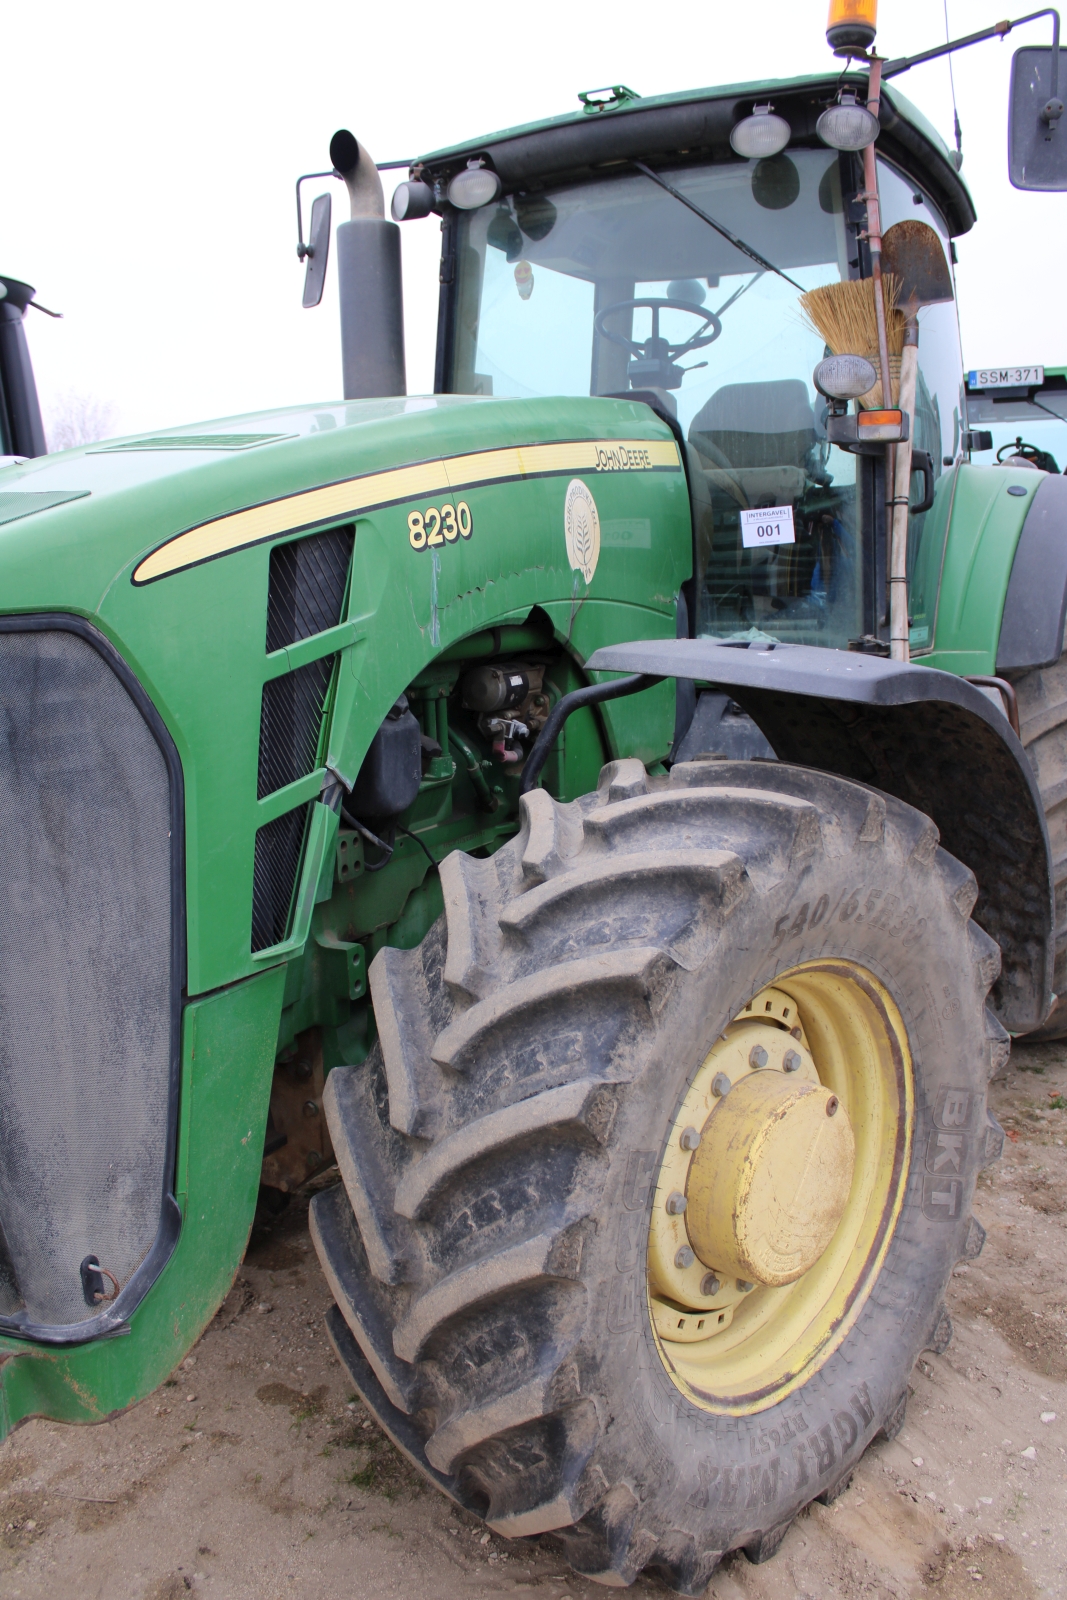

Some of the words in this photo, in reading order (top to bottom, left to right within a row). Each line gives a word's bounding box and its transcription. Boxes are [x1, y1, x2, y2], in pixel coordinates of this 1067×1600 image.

[980, 368, 1039, 384] SSM-371
[595, 446, 621, 467] JOHN
[619, 446, 651, 467] DEERE
[748, 509, 787, 519] INTERGAVEL
[407, 501, 473, 552] 8230
[757, 523, 781, 538] 001
[932, 1089, 970, 1216] BKT
[749, 1411, 809, 1458] RT657
